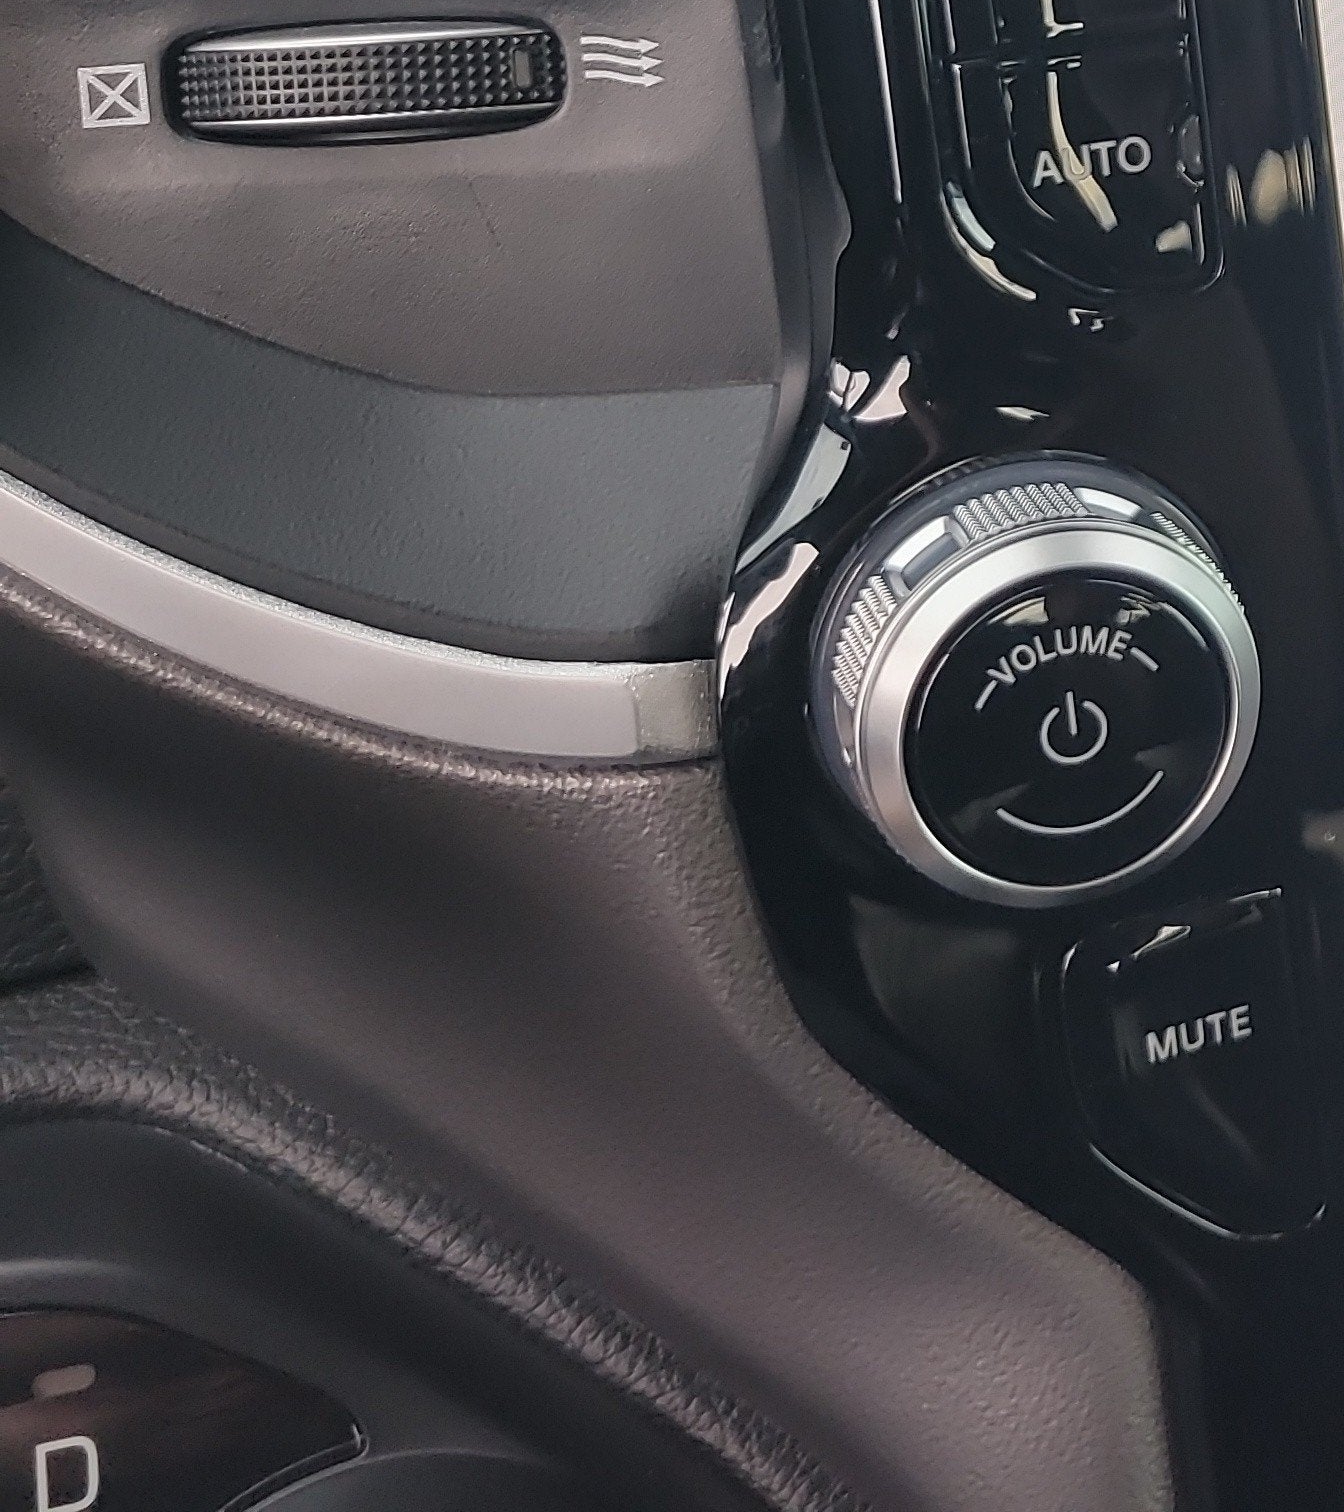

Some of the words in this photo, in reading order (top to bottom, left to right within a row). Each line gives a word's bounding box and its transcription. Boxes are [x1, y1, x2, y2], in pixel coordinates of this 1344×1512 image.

[1032, 135, 1151, 189] AUTO
[986, 625, 1133, 686] VOLUME
[1145, 1004, 1253, 1064] MUTE
